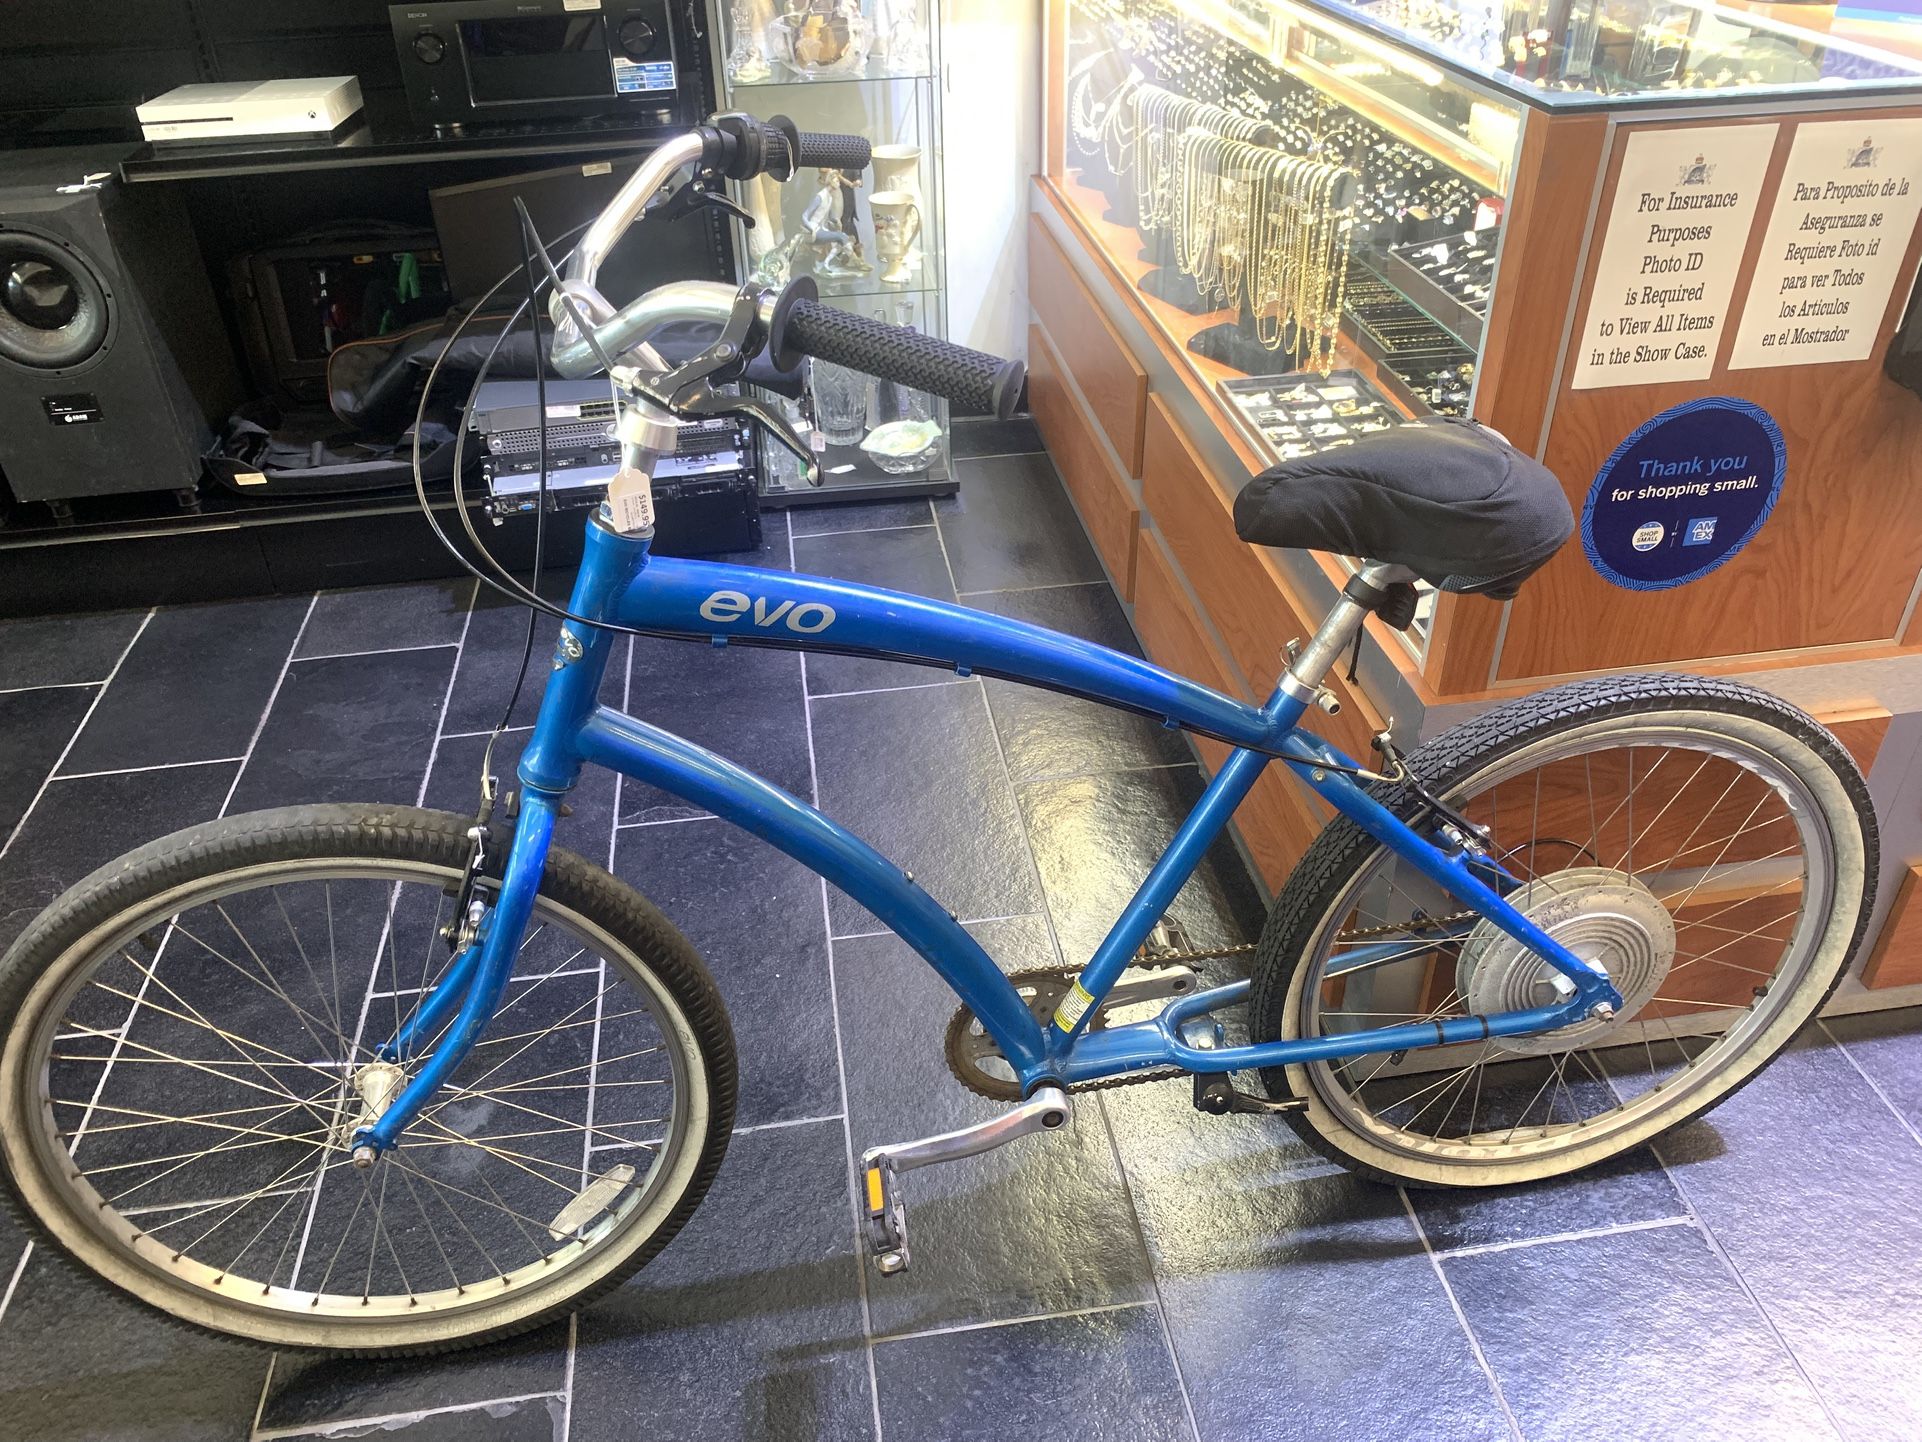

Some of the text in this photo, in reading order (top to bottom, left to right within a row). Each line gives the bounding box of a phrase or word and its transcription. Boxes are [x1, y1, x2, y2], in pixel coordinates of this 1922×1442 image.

[1637, 191, 1738, 213] For Insurance
[1793, 177, 1910, 204] Para Proposito de la
[1799, 212, 1883, 235] Aseguranza se
[1647, 224, 1712, 247] Purposes
[1640, 252, 1703, 275] Photo ID
[1784, 238, 1881, 266] Requiere Foto id
[1779, 268, 1865, 295] para ver Todos
[1624, 283, 1705, 308] is Required
[1778, 301, 1797, 318] los
[1599, 312, 1715, 337] to View All Items
[1762, 326, 1850, 347] en el Mostrador
[1590, 342, 1708, 366] in the Show Case.
[1639, 454, 1748, 479] Thank you
[1611, 475, 1759, 502] for shopping small.
[1636, 536, 1658, 544] SMALL
[1640, 530, 1659, 538] SHOP
[1694, 530, 1712, 541] EX
[700, 590, 836, 634] evo
